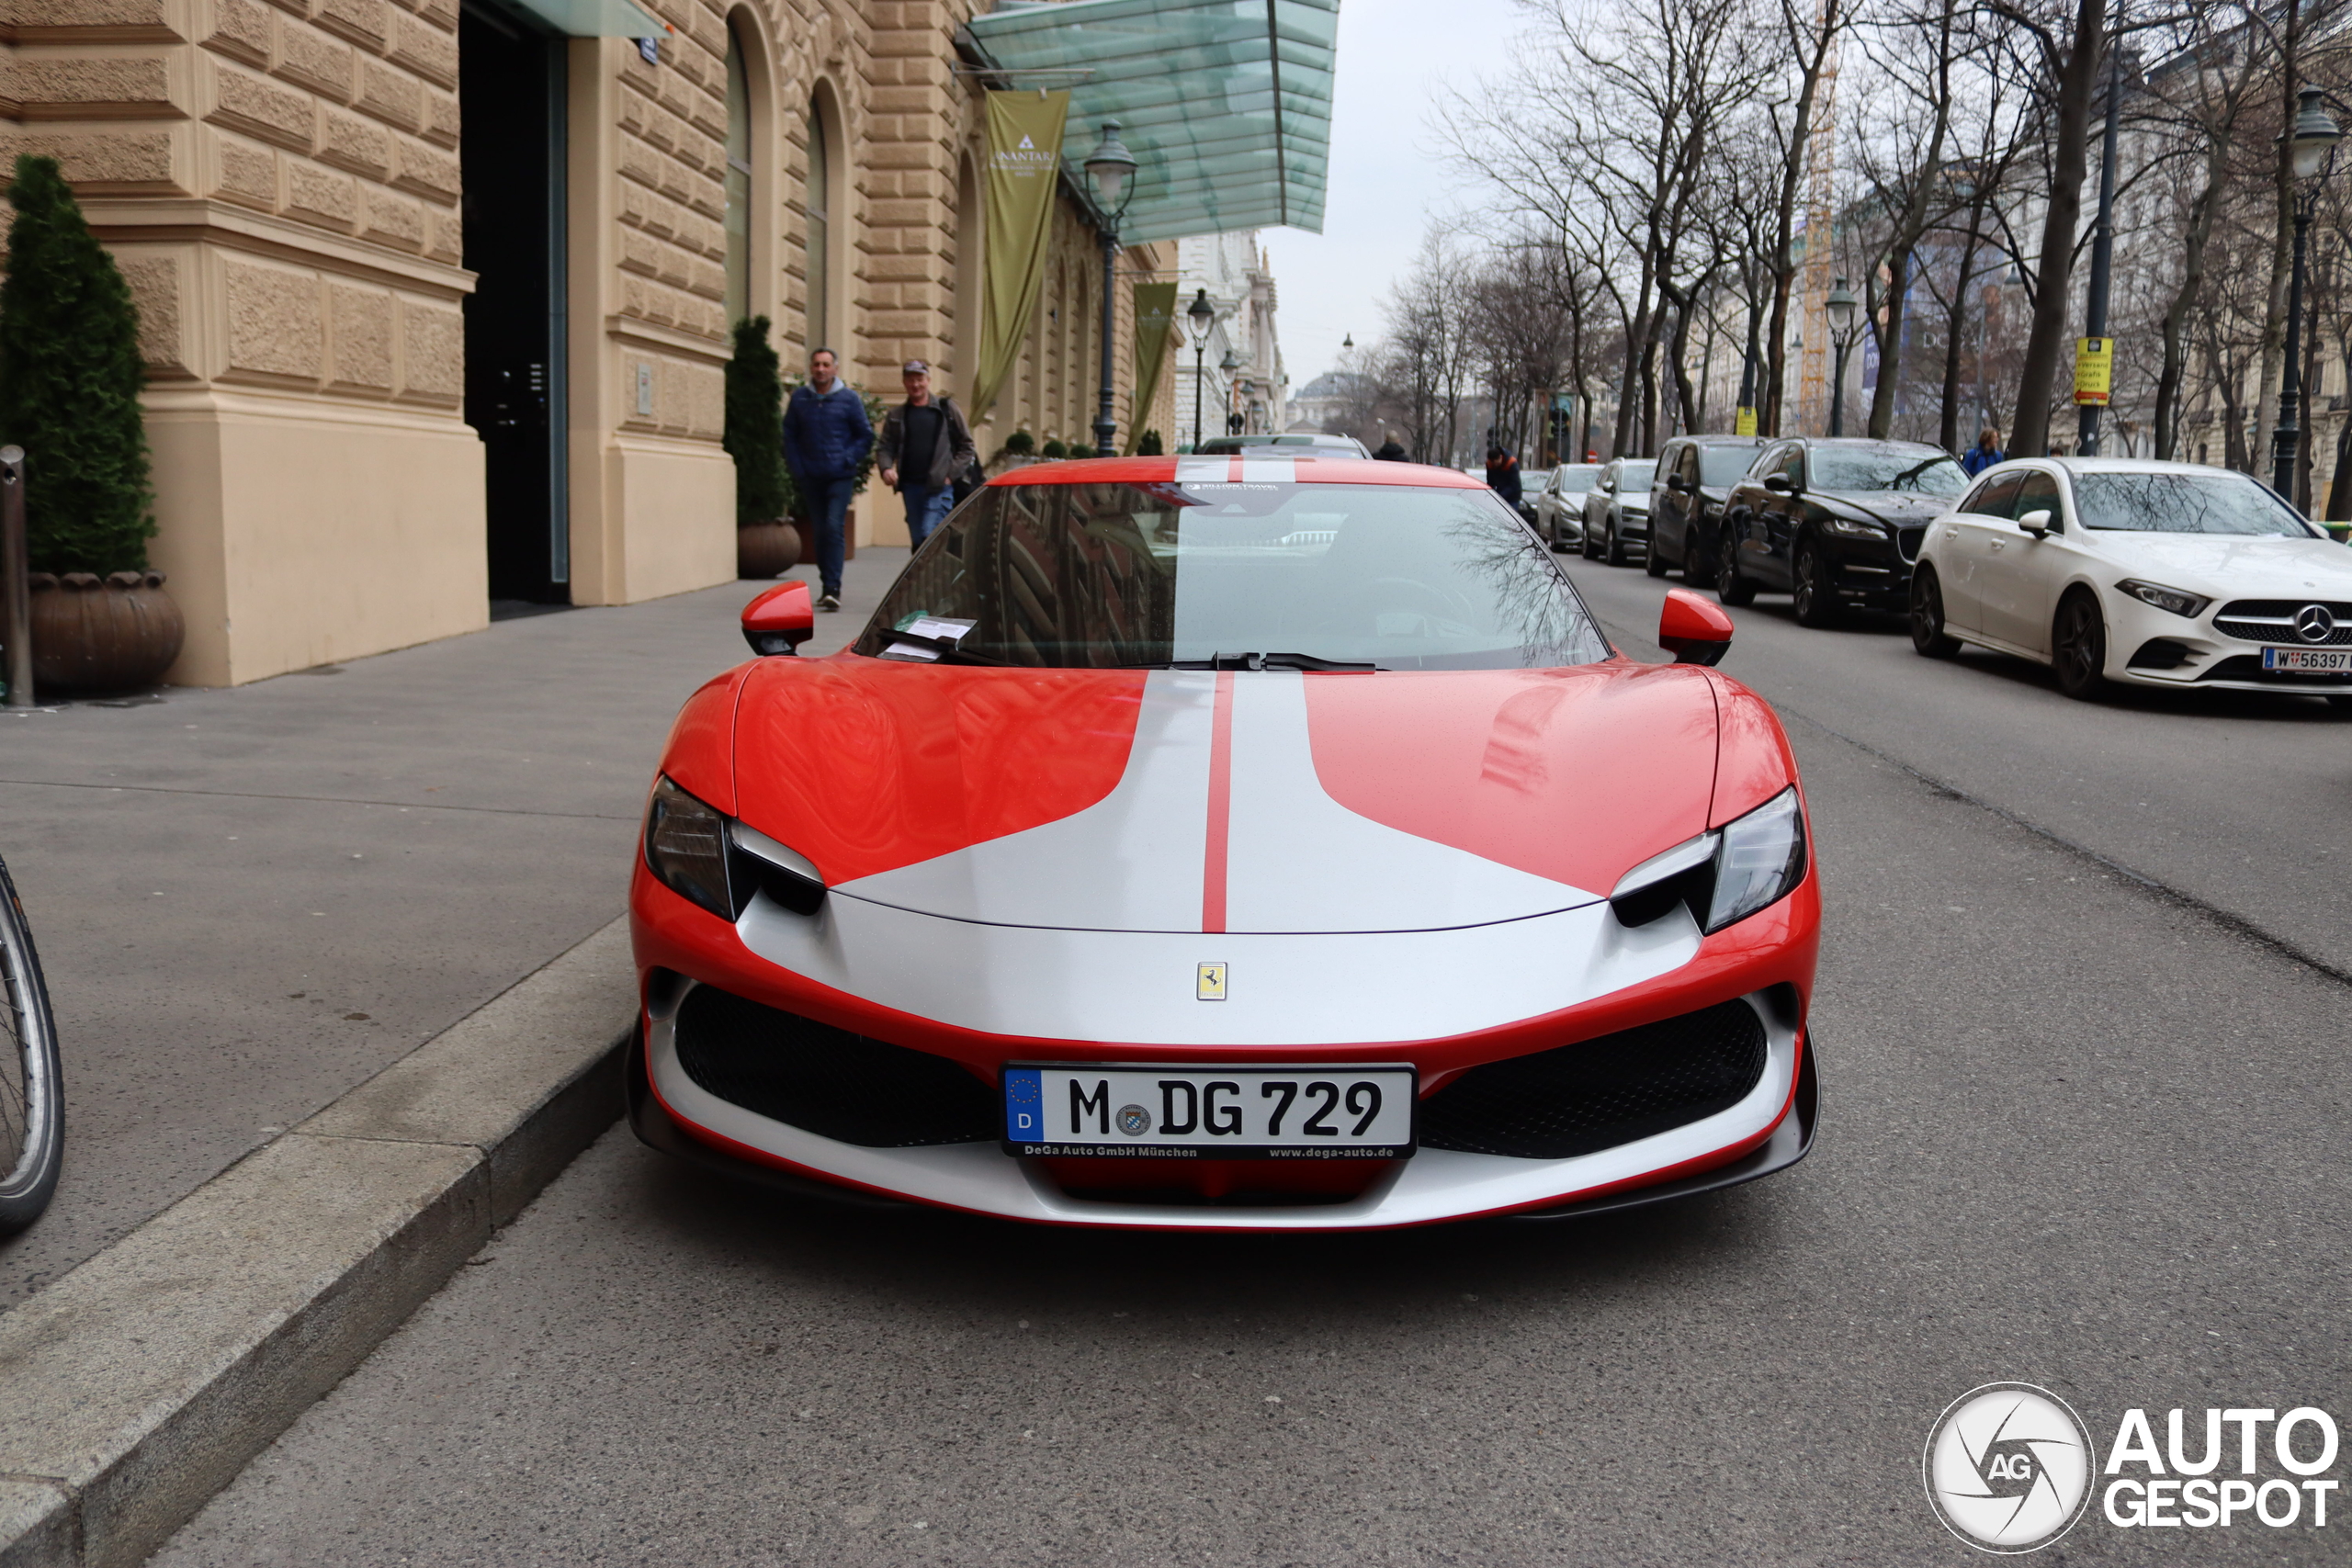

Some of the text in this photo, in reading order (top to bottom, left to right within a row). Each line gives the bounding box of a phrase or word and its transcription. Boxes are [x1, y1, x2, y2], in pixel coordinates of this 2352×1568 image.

[2278, 652, 2346, 669] W 56397
[1070, 1079, 1109, 1134] M
[1159, 1080, 1242, 1135] DG
[1261, 1081, 1382, 1136] 729
[1018, 1113, 1032, 1129] D
[1024, 1145, 1197, 1157] DeGa Auto GmbH München
[1270, 1148, 1394, 1158] www.dega-auto.de
